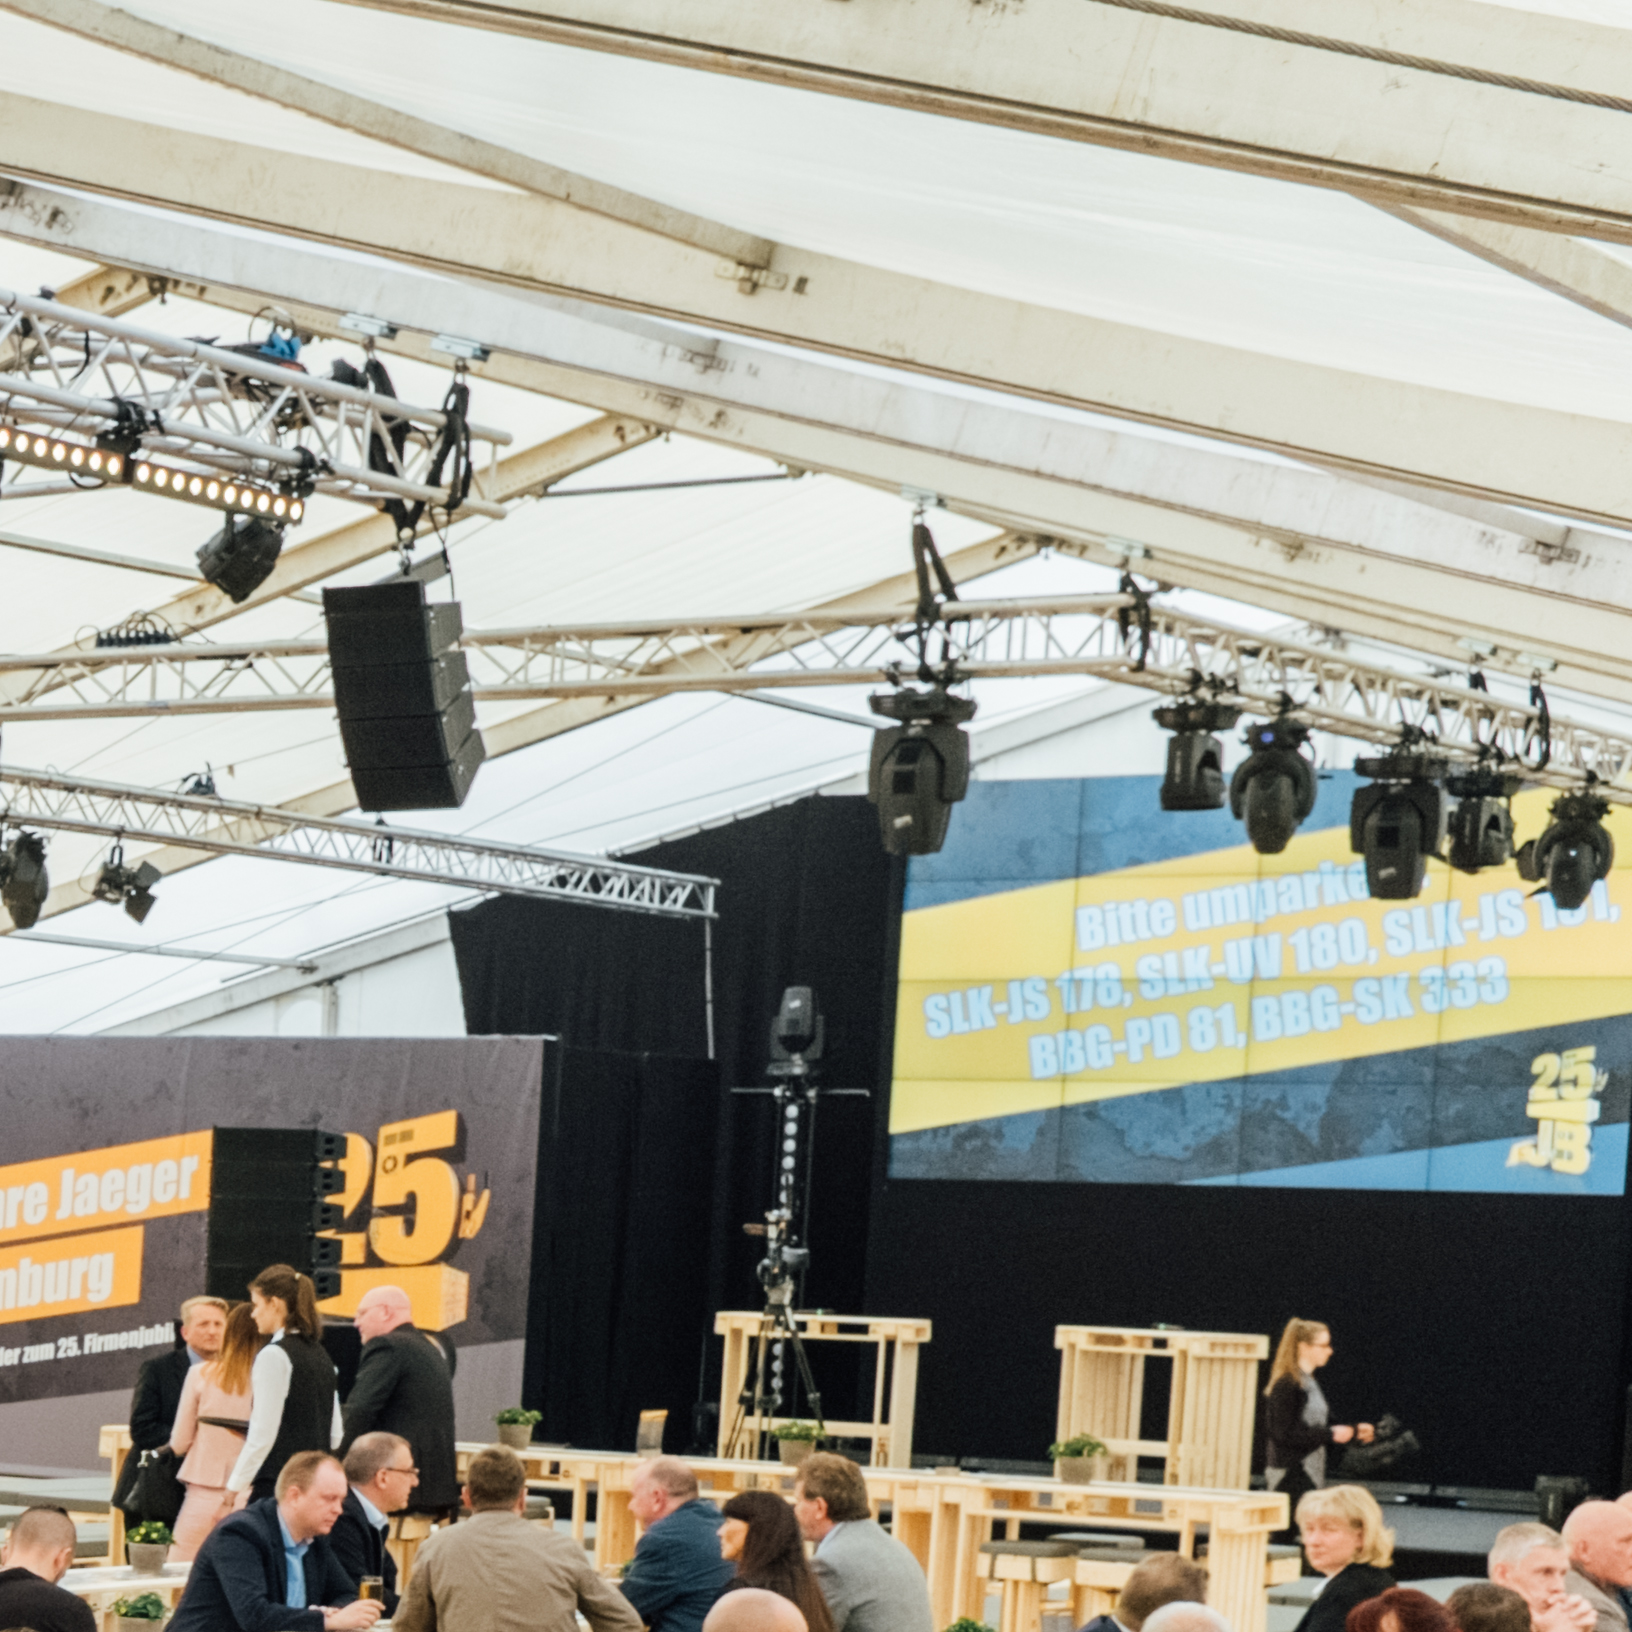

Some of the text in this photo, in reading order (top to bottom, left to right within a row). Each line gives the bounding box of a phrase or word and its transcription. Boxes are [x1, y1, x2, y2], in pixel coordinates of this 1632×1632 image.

[1075, 860, 1372, 952] Bitte umparke
[924, 976, 1051, 1038] SLK-JS
[1055, 962, 1133, 1013] 178,
[1137, 932, 1282, 1000] SLK-UV
[1288, 917, 1379, 973] 180,
[1383, 888, 1528, 957] SLK-JS
[1028, 955, 1510, 1080] BBG-PD 81, BBG-SK 333
[1529, 1046, 1596, 1100] 25
[57, 1155, 199, 1220] Jaeger
[23, 1342, 55, 1363] zum
[57, 1336, 81, 1359] 25.
[83, 1322, 176, 1355] Firmenjubil
